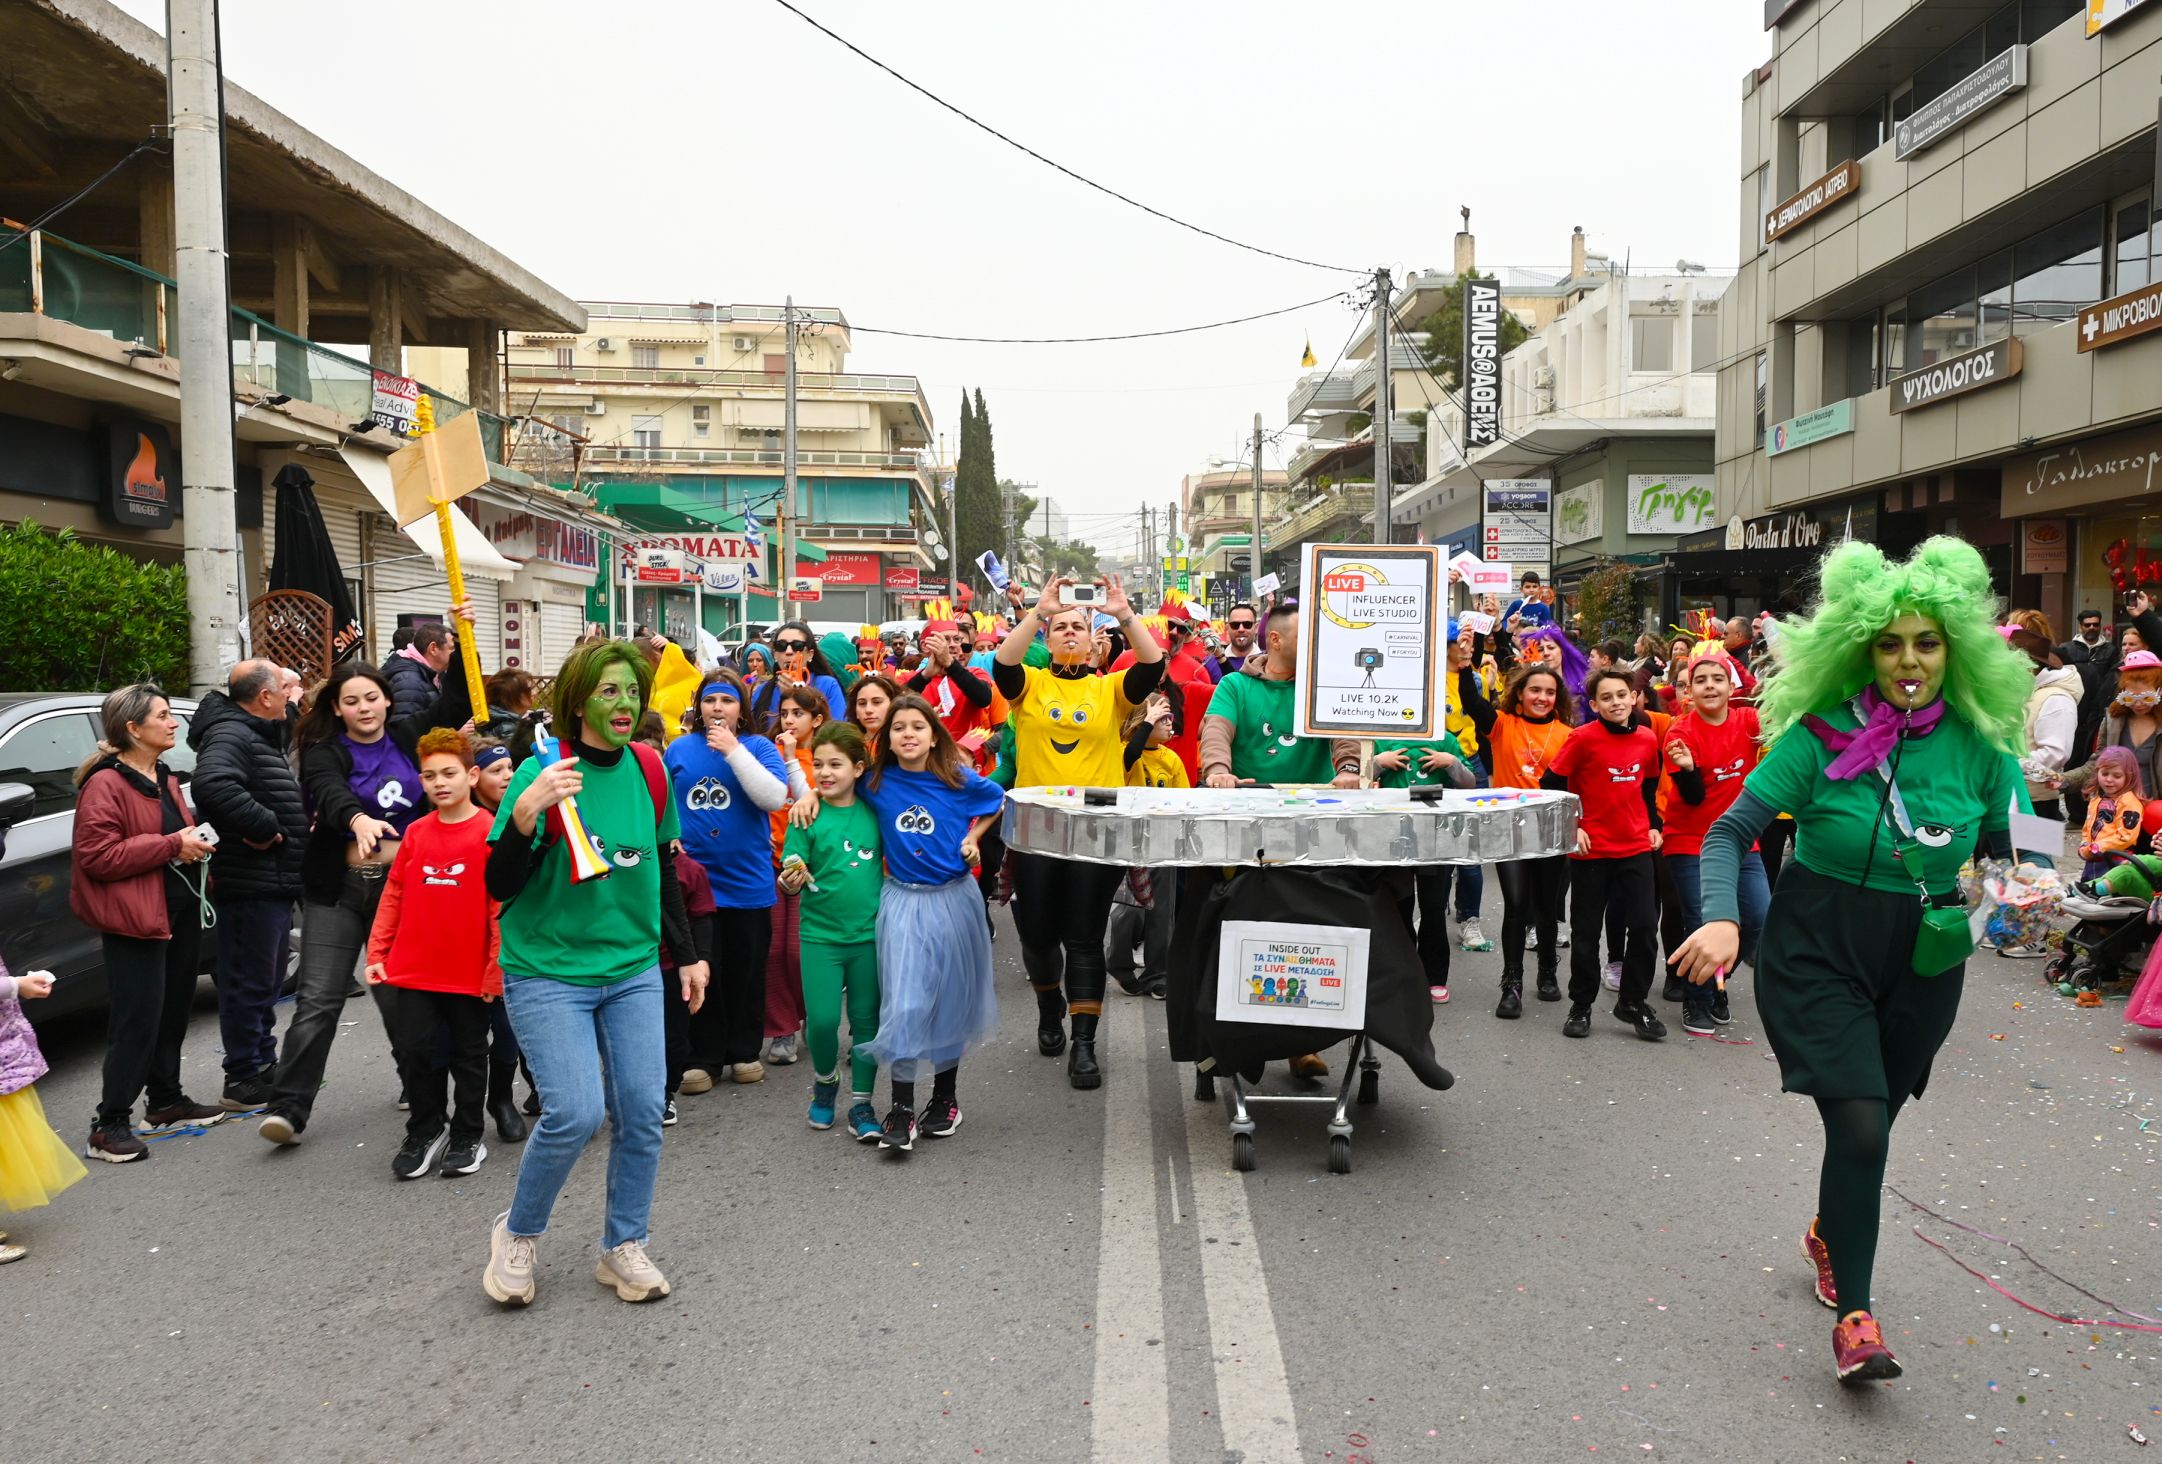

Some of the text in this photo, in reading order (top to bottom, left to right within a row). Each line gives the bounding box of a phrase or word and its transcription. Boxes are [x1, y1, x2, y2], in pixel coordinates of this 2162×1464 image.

[1913, 56, 2010, 128] ΦΙΛΙΠΠΟΣ ΠΑΠΑΧΡΙΣΤΟΔΟΥΛΟΥ
[1912, 113, 1951, 144] Διαιτολόγος
[1955, 74, 2010, 116] Διατροφολόγος
[1778, 169, 1848, 230] ΔΕΡΜΑΤΟΛΟΓΙΚΟ ΙΑΤΡΕΙΟ
[1903, 350, 1995, 403] ΨΥΧΟΛΟΓΟΣ
[1745, 519, 1780, 549] Pasta
[1781, 512, 1821, 548] d'Oro
[536, 516, 597, 568] ΕΡΓΑΛΕΙΑ
[710, 573, 739, 585] Vitex
[821, 574, 853, 582] Crystal
[889, 577, 914, 585] Crystal
[1328, 578, 1360, 590] LIVE
[1352, 595, 1416, 605] INFLUENCER
[1353, 609, 1418, 618] LIVE STUDIO
[1341, 694, 1399, 704] LIVE 10.2K
[1332, 707, 1399, 719] Watching Now
[1269, 944, 1321, 955] INSIDE OUT
[1253, 953, 1336, 967] ΤΑ ΣΥΝΑΙΣΘΗΜΑΤΑ
[1254, 964, 1335, 976] ΣΕ LIVE ΜΕΤΑΔΟΣΗ
[1321, 978, 1340, 986] LIVE
